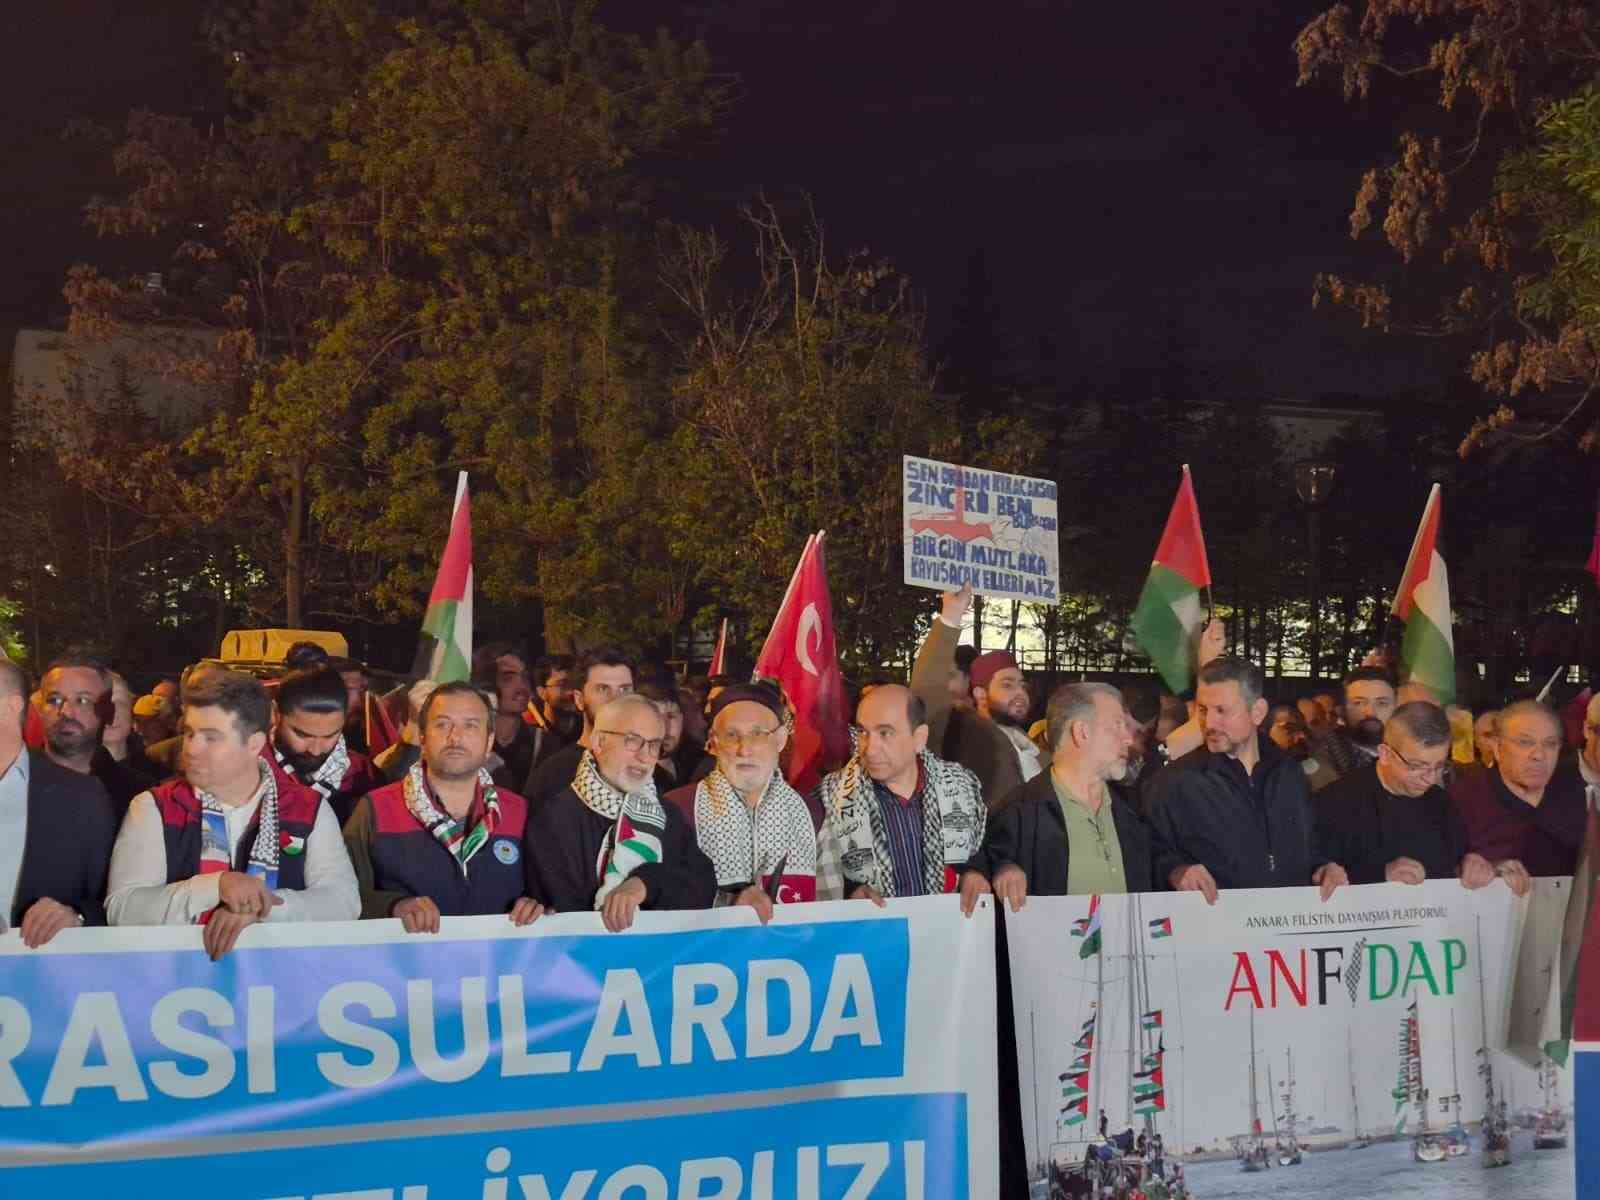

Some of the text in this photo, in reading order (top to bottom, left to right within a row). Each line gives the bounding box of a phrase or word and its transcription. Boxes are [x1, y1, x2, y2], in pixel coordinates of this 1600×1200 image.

[906, 461, 939, 482] SEN
[971, 544, 1048, 577] MUTLAKA
[1246, 914, 1289, 929] ANKARA
[316, 954, 882, 1089] SULARDA
